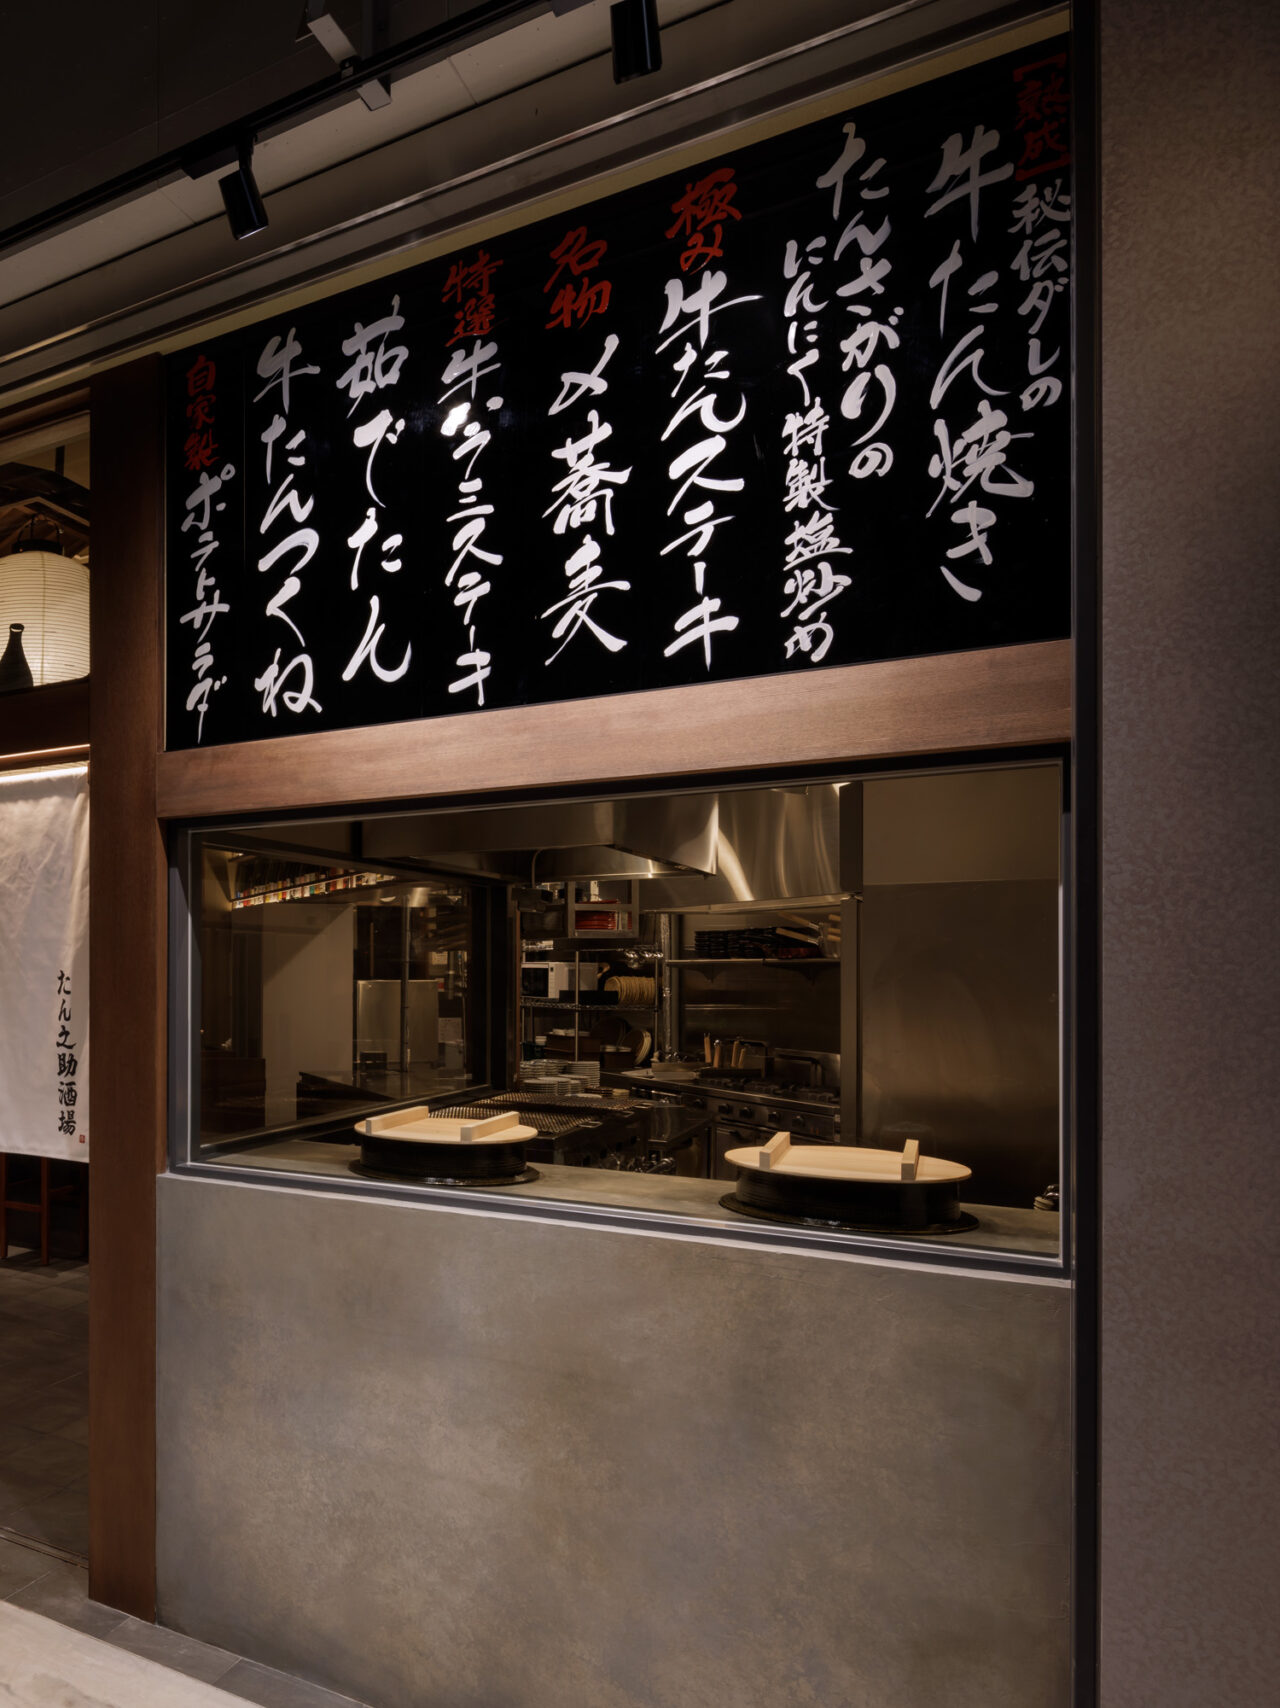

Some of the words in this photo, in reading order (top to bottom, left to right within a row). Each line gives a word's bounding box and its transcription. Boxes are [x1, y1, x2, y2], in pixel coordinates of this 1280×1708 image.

[335, 293, 412, 684] 茹でたん
[779, 236, 854, 663] にんにく特製塩炒め
[816, 121, 904, 480] たんさがりの
[925, 123, 1036, 603] 牛たん焼き
[253, 326, 324, 719] 牛たんつくね
[56, 970, 78, 1136] たん之助酒場
